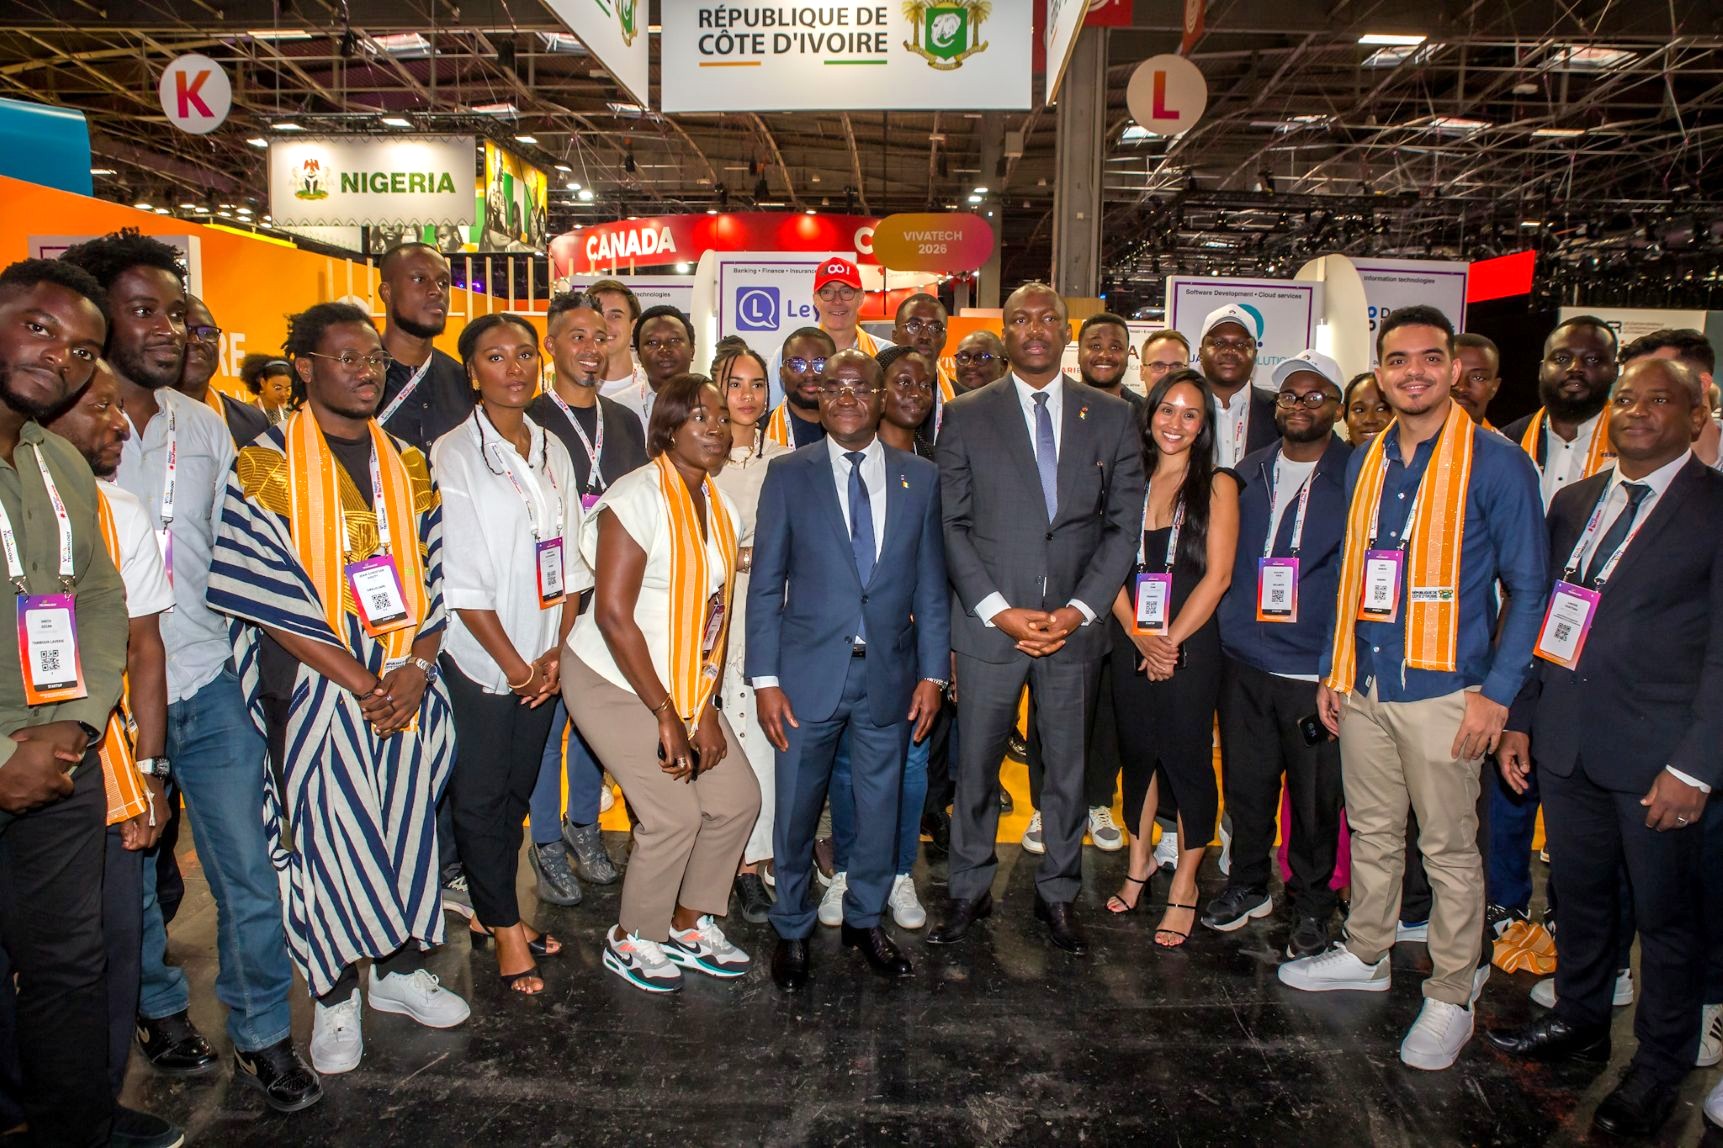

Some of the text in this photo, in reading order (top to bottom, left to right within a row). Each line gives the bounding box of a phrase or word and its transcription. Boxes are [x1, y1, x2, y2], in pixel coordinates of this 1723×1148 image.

[699, 4, 887, 28] RÉPUBLIQUE DE
[698, 30, 888, 55] CÔTE D'IVOIRE
[175, 70, 215, 118] K
[1152, 70, 1180, 119] L
[340, 171, 456, 194] NIGERIA
[586, 227, 676, 261] CANADA
[903, 230, 963, 242] VIVATECH
[918, 244, 948, 255] 2026
[733, 267, 757, 275] Banking
[1398, 277, 1435, 285] technologies
[1185, 288, 1212, 296] Software
[1214, 289, 1253, 298] Development
[1258, 291, 1276, 299] Cloud
